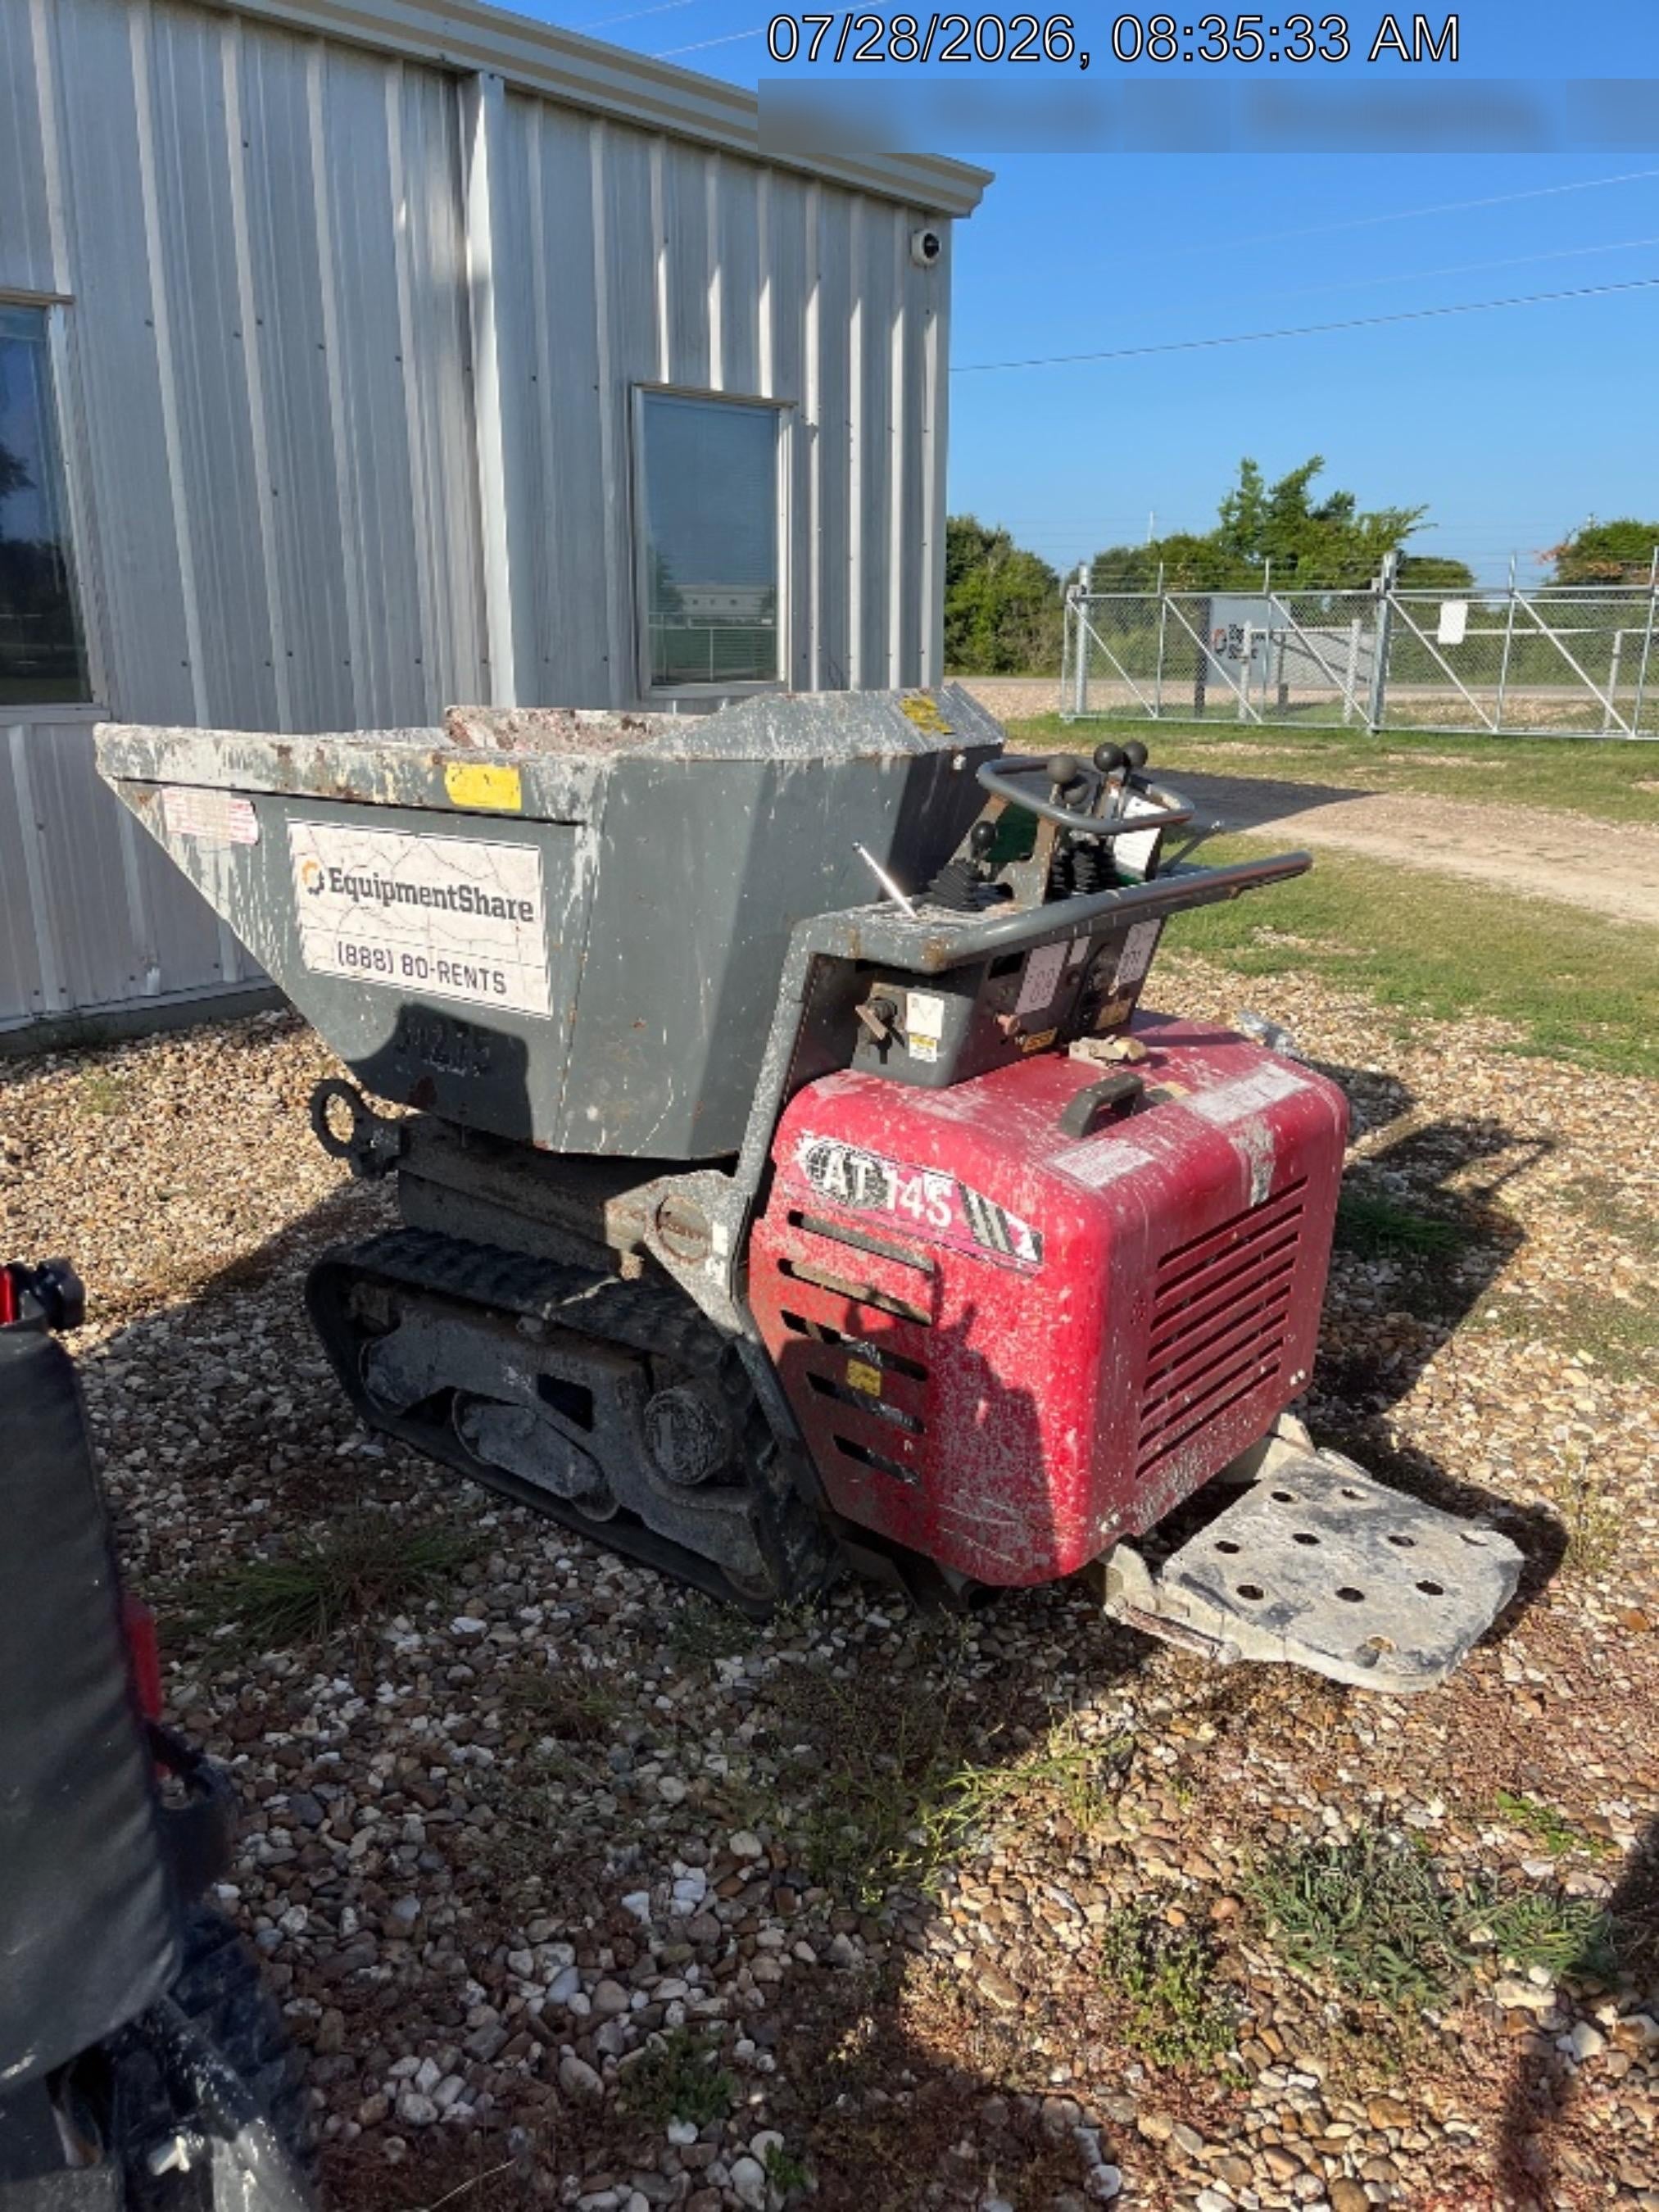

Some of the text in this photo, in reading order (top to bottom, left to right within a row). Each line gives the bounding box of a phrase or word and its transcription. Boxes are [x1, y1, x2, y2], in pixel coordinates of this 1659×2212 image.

[328, 867, 534, 922] EquipmentShare
[337, 941, 507, 995] (888) 80-RENTS
